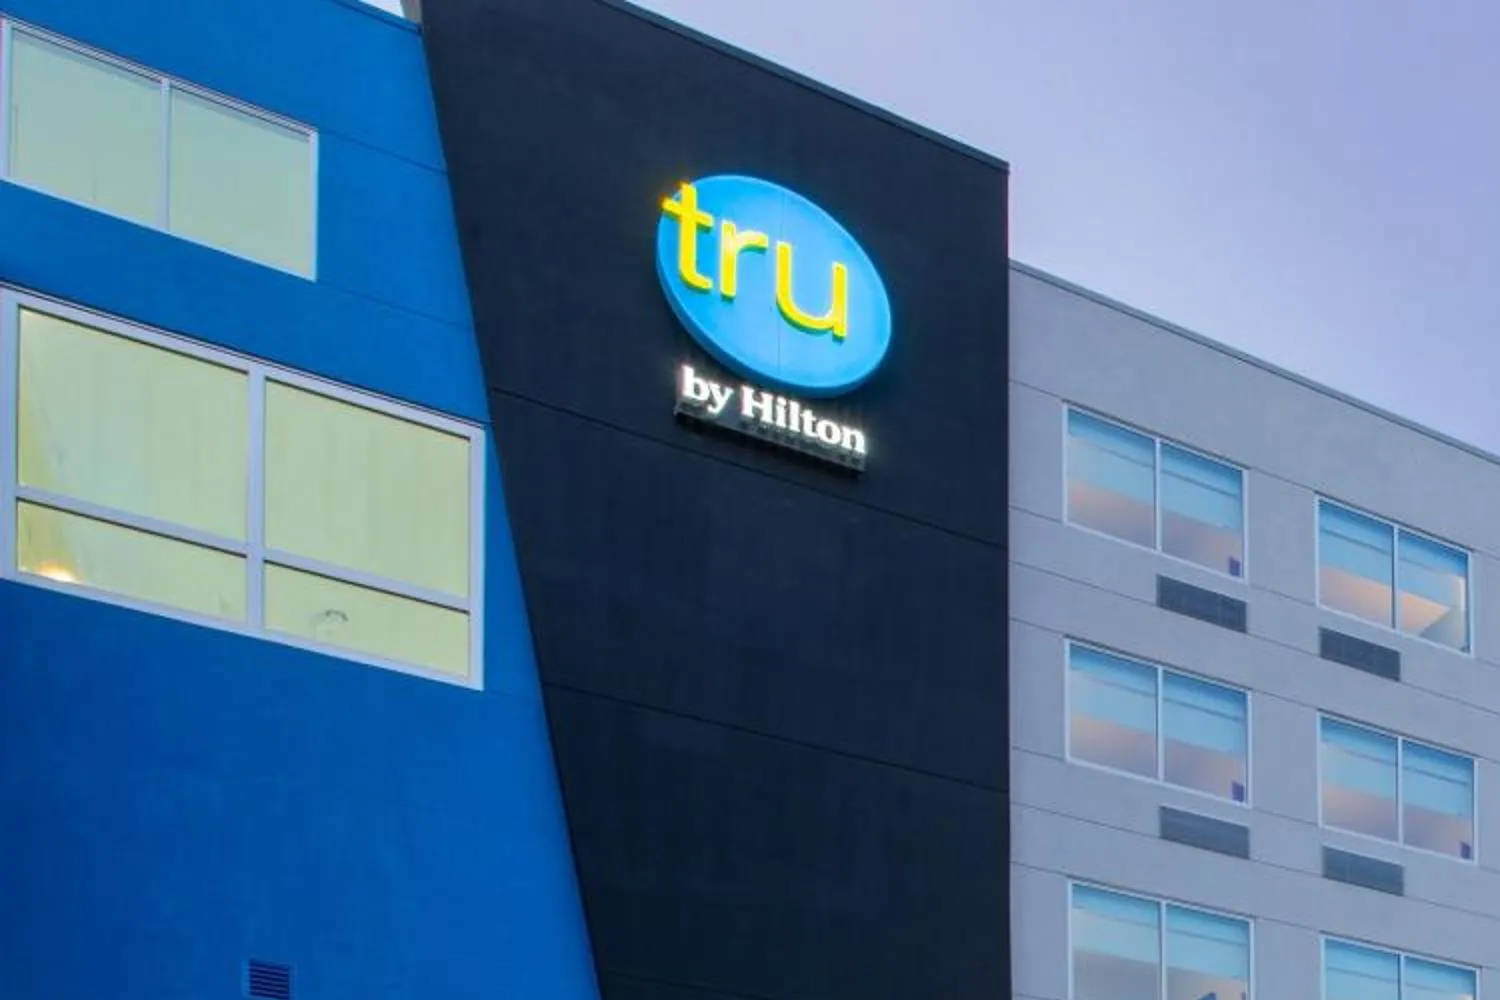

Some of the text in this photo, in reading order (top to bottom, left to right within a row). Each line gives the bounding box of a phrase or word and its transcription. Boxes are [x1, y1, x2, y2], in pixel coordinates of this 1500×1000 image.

[660, 182, 848, 340] tru
[681, 364, 866, 454] by Hilton
